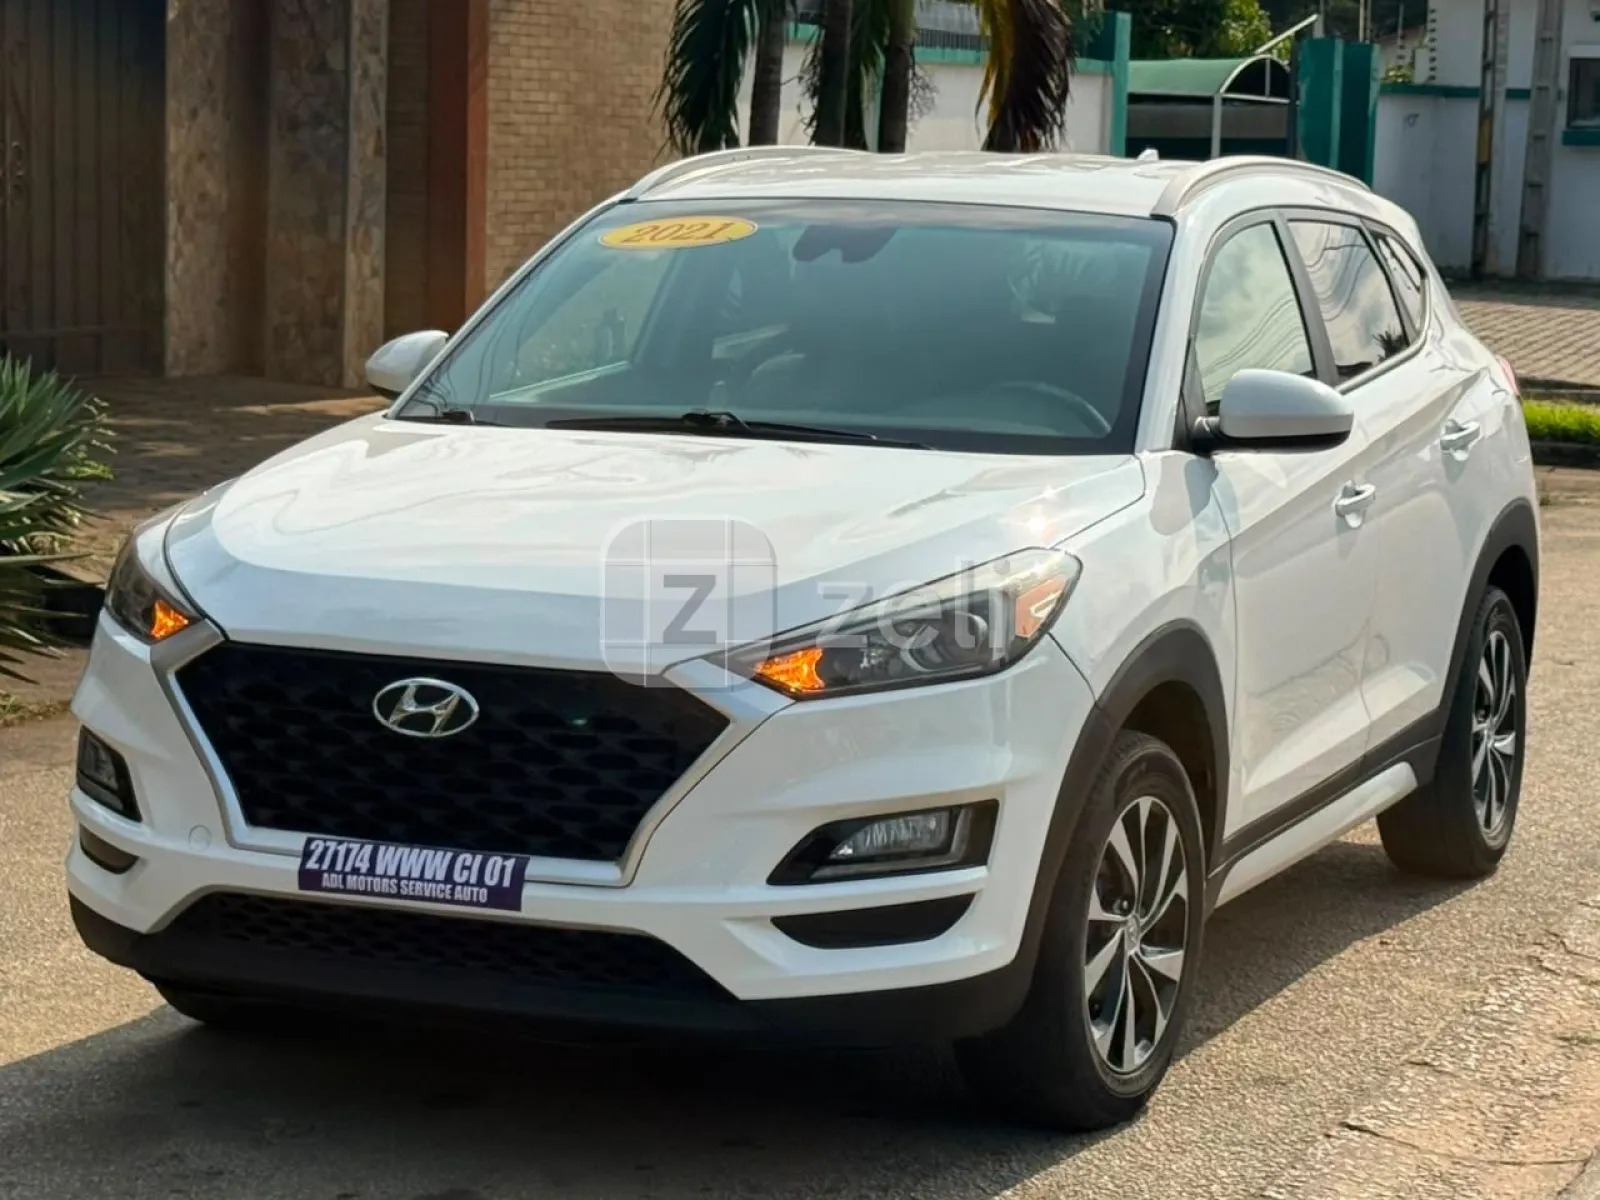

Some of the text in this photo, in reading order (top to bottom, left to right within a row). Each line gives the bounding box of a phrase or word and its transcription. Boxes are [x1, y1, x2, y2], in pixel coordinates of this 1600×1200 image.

[620, 222, 735, 244] 2021
[305, 839, 516, 888] 27174 WWW CI 01
[321, 873, 489, 903] ADL MOTORS SERVICE AUTO
